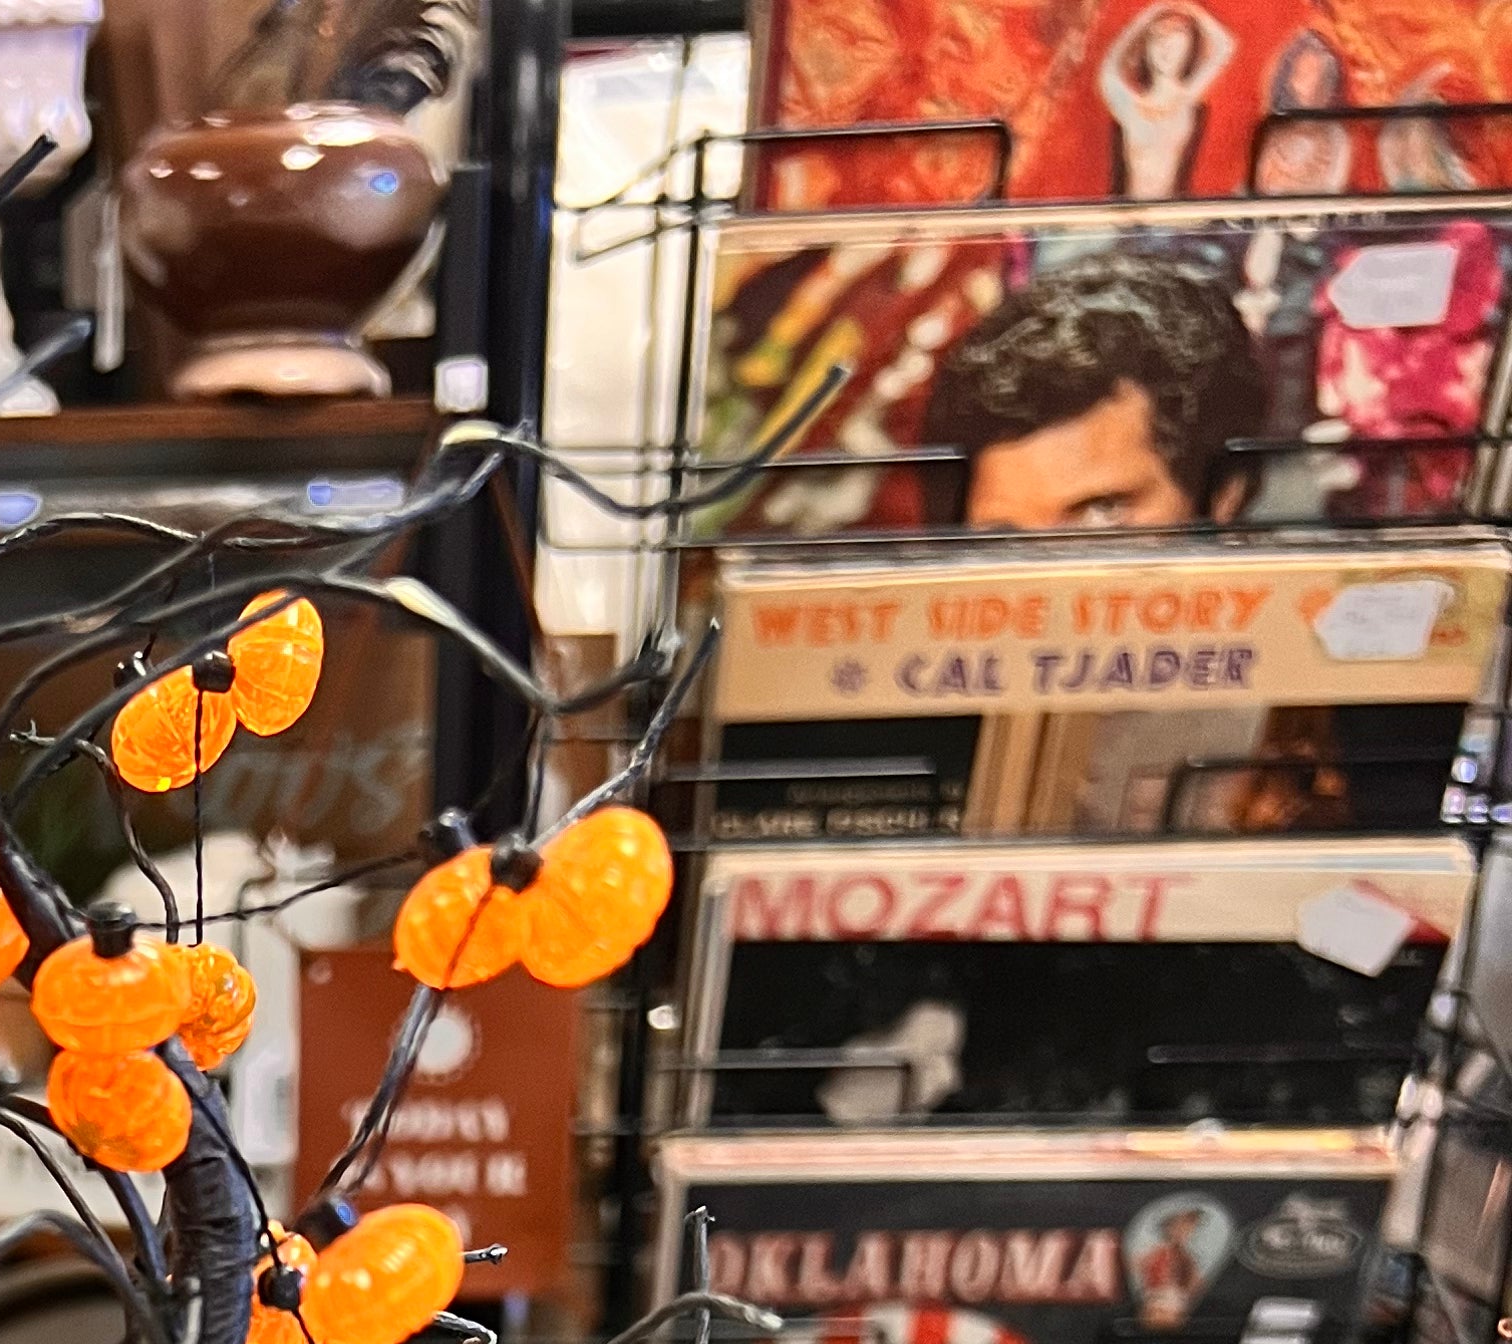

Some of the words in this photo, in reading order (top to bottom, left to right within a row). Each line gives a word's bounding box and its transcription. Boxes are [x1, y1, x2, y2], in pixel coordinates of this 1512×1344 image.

[751, 602, 901, 647] WEST
[926, 595, 1051, 642] SIDE
[1071, 589, 1272, 635] STORY
[895, 651, 1003, 696] CAL
[1032, 645, 1258, 693] TJADER
[732, 874, 1196, 941] MOZART
[701, 1229, 1120, 1303] OKLAHOMA
